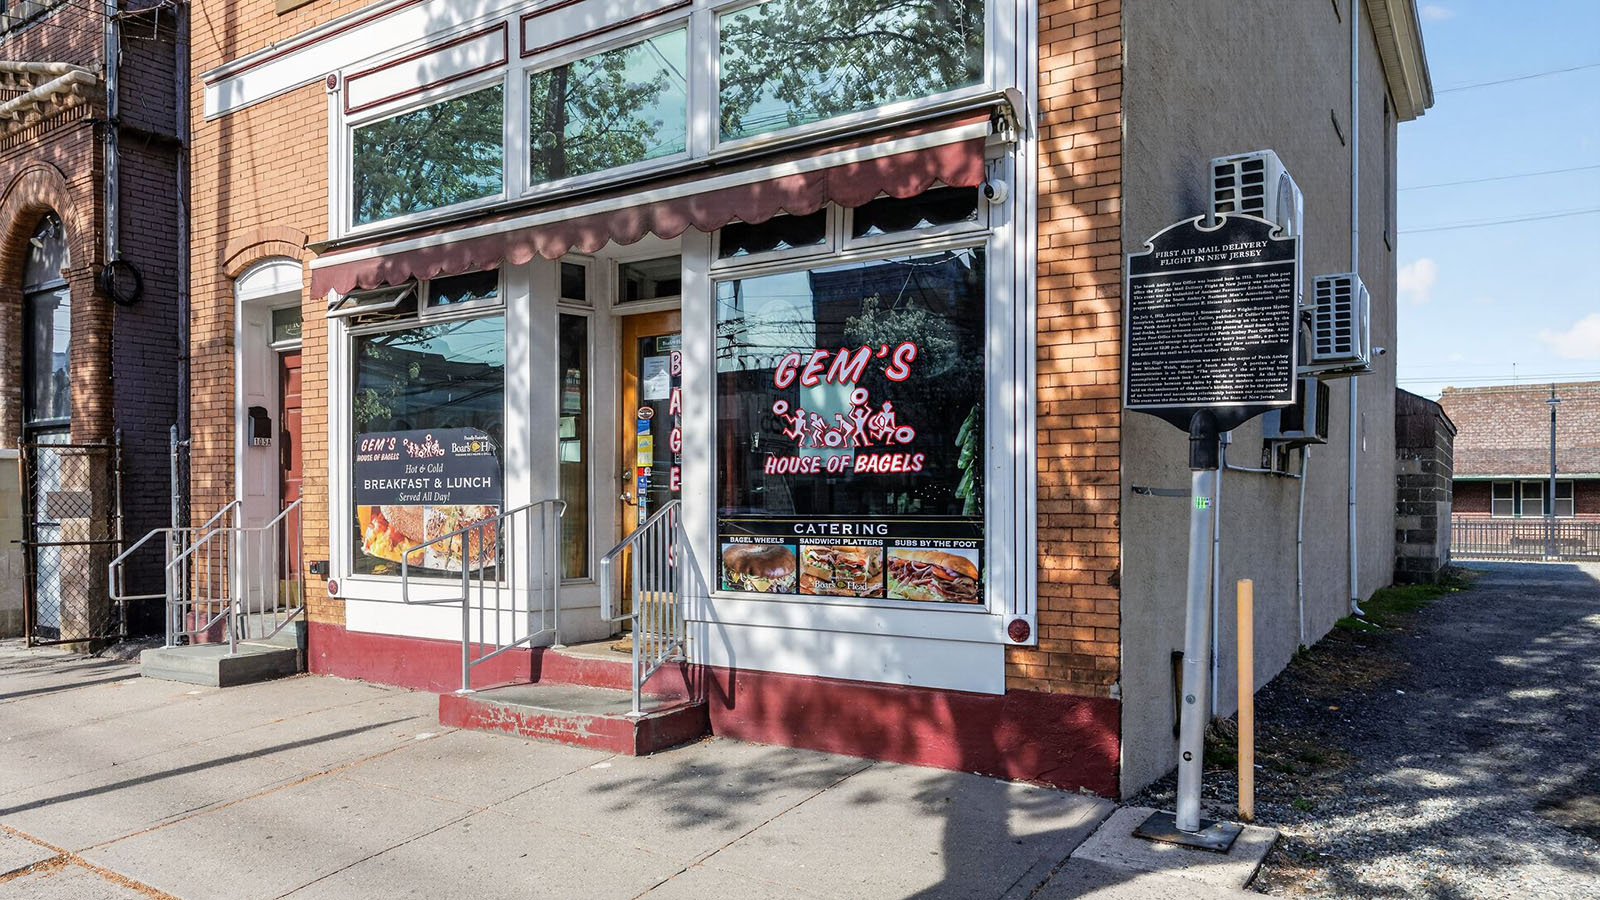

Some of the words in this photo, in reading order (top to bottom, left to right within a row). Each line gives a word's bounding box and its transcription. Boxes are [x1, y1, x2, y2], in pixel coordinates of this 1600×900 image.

[1156, 250, 1179, 258] FIRST
[1181, 248, 1196, 256] AIR
[1198, 246, 1220, 254] MAIL
[1222, 240, 1268, 252] DELIVERY
[1160, 256, 1192, 266] FLIGHT
[1194, 254, 1204, 262] IN
[1207, 252, 1228, 261] NEW
[1229, 250, 1262, 260] JERSEY
[774, 341, 917, 388] GEM'S
[361, 437, 396, 452] GEM'S
[357, 454, 373, 462] HOUSE
[381, 453, 400, 461] BAGELS
[765, 456, 821, 474] HOUSE
[826, 455, 851, 473] OF
[854, 453, 925, 473] BAGELS
[405, 464, 418, 474] Hot
[419, 465, 425, 473] &
[427, 464, 444, 473] Cold
[364, 478, 430, 489] BREAKFAST
[434, 478, 442, 488] &
[446, 477, 491, 488] LUNCH
[399, 492, 420, 502] Served
[422, 492, 432, 501] All
[434, 492, 450, 504] Day!
[794, 524, 888, 534] CATERING
